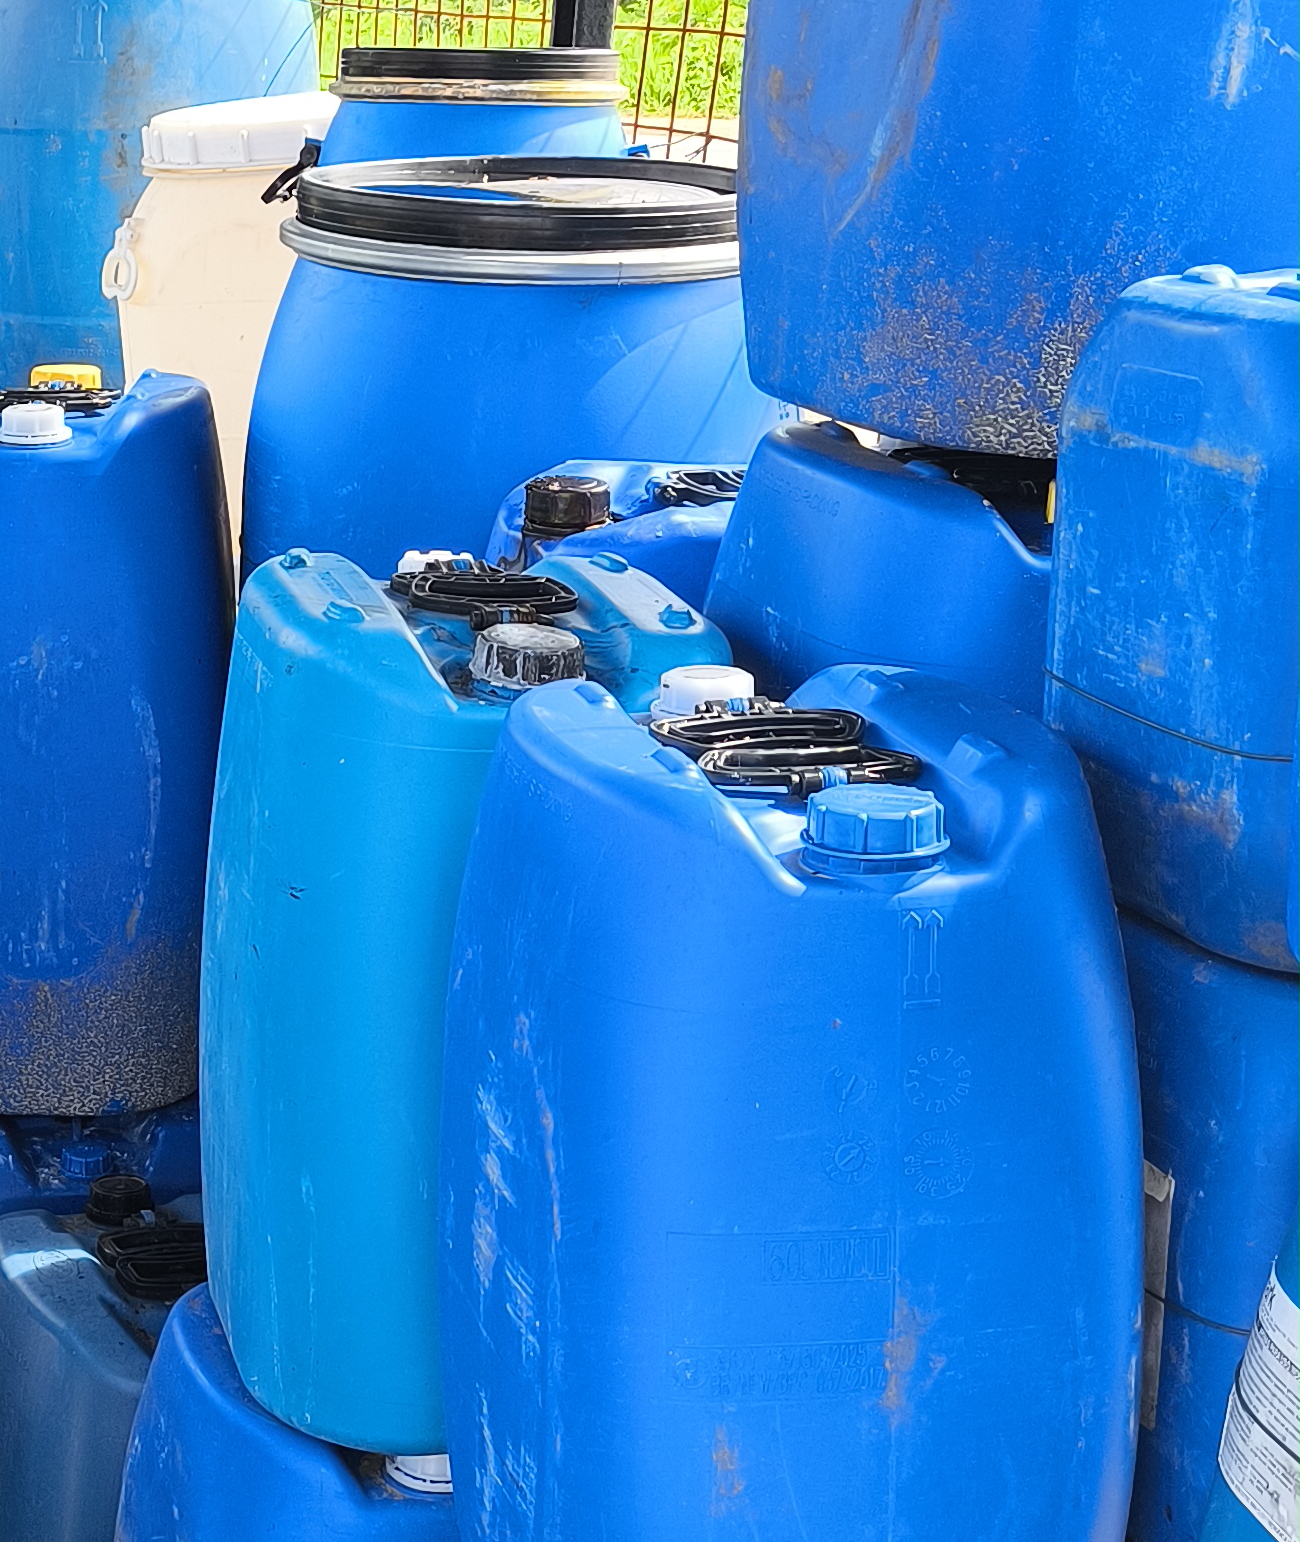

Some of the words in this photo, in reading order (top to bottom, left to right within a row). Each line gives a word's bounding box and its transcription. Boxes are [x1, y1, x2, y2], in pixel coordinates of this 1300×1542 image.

[917, 1054, 928, 1067] 5
[931, 1047, 939, 1060] 6
[944, 1047, 953, 1060] 7
[953, 1055, 966, 1068] 8
